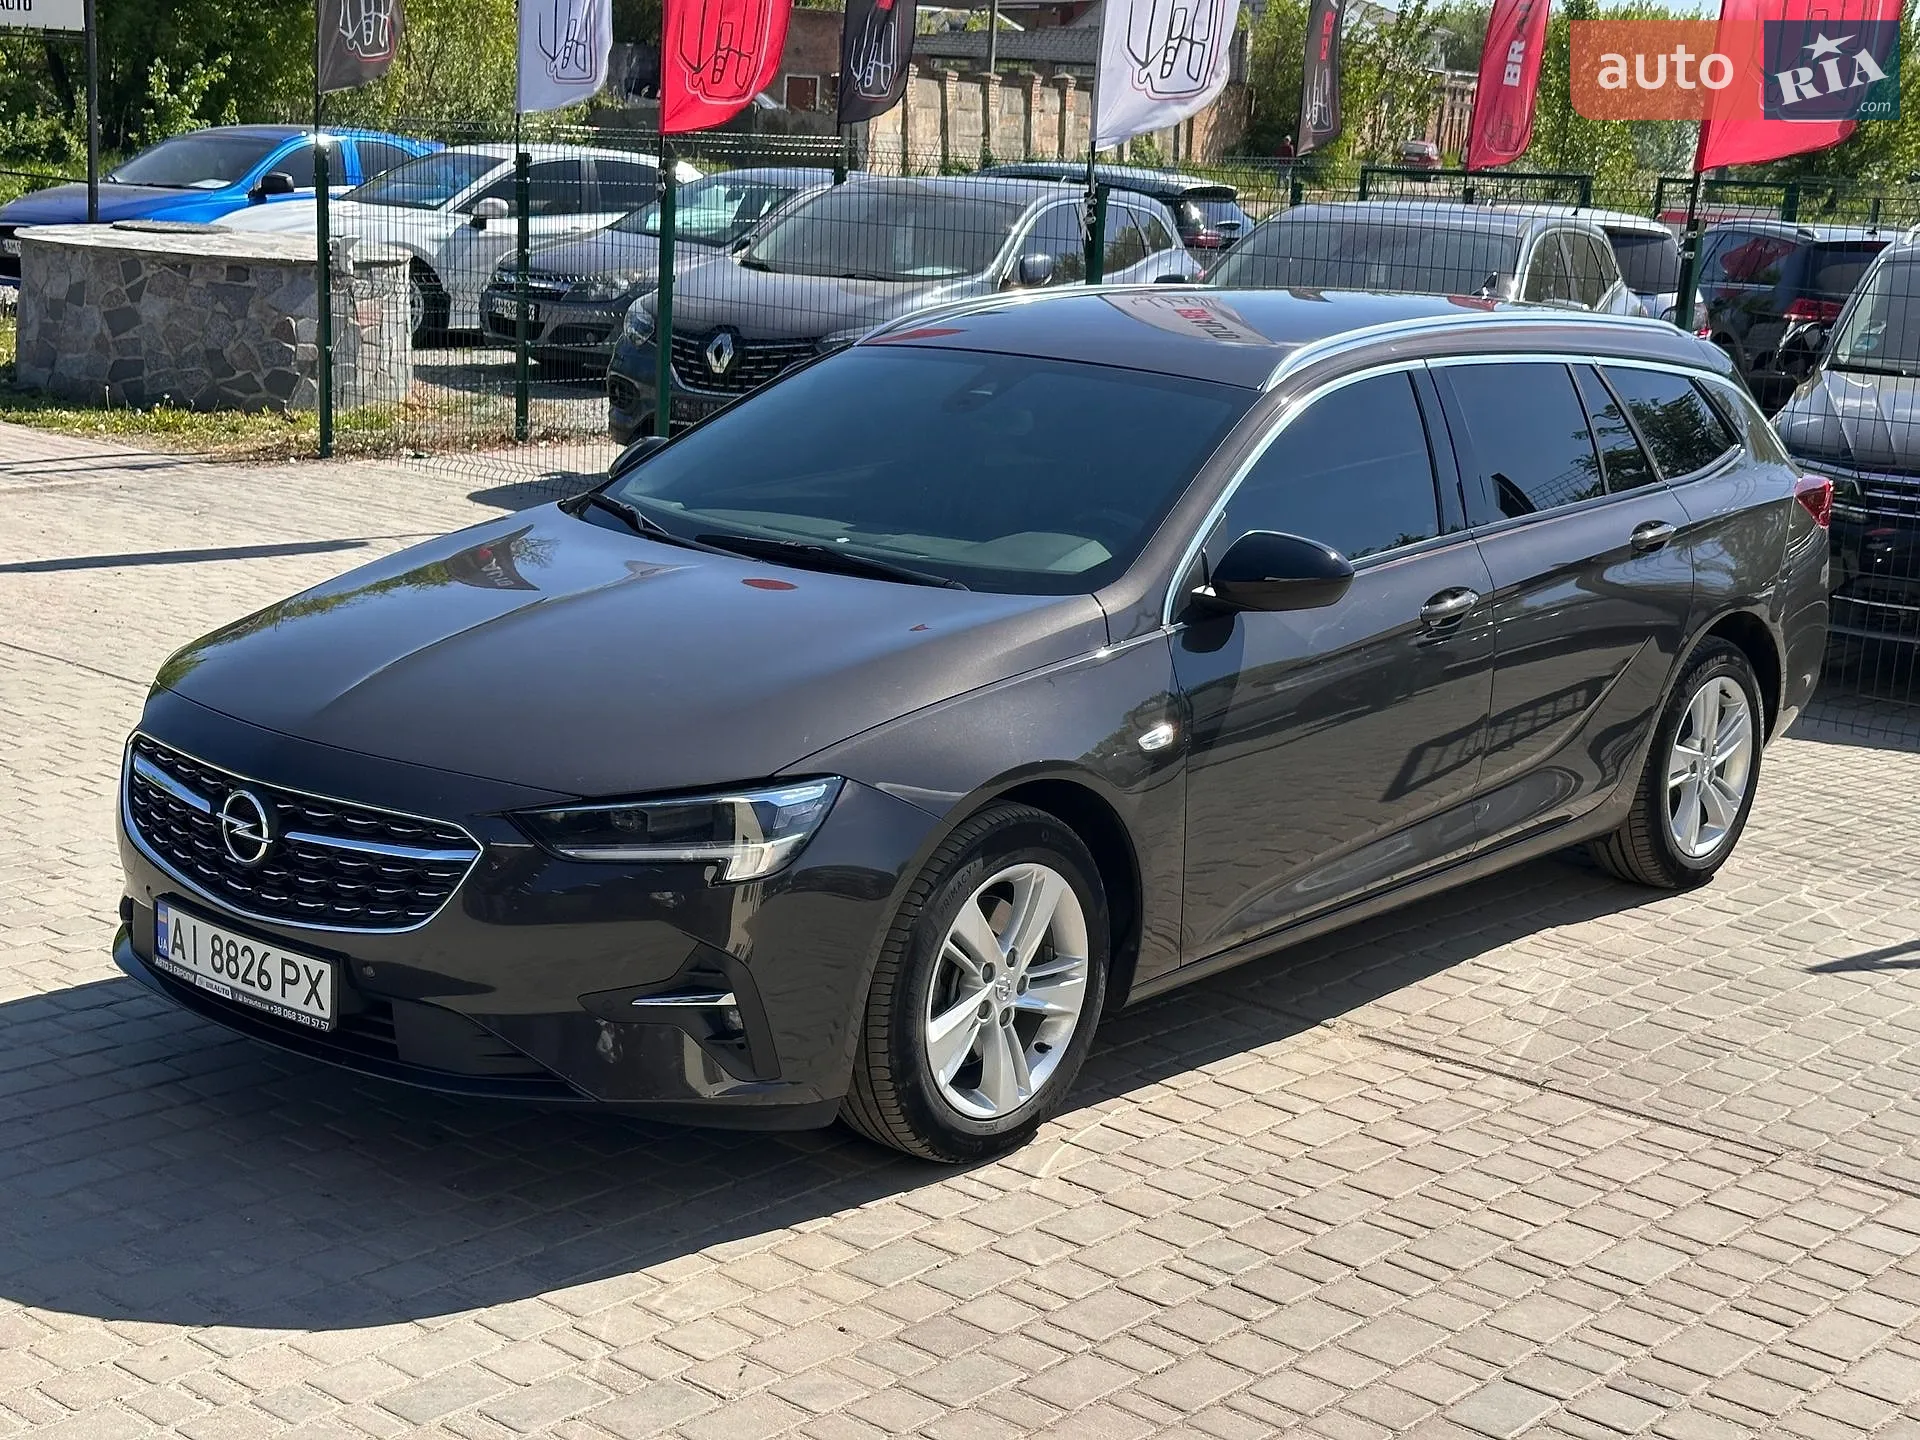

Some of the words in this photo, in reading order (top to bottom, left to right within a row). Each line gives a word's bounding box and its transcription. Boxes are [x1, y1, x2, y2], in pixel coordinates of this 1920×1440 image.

[158, 940, 169, 951] UA
[171, 917, 199, 966] AI
[210, 933, 272, 992] 8826
[280, 957, 325, 1011] PX
[297, 1013, 310, 1025] 320
[311, 1018, 320, 1028] 57
[320, 1021, 330, 1031] 57
